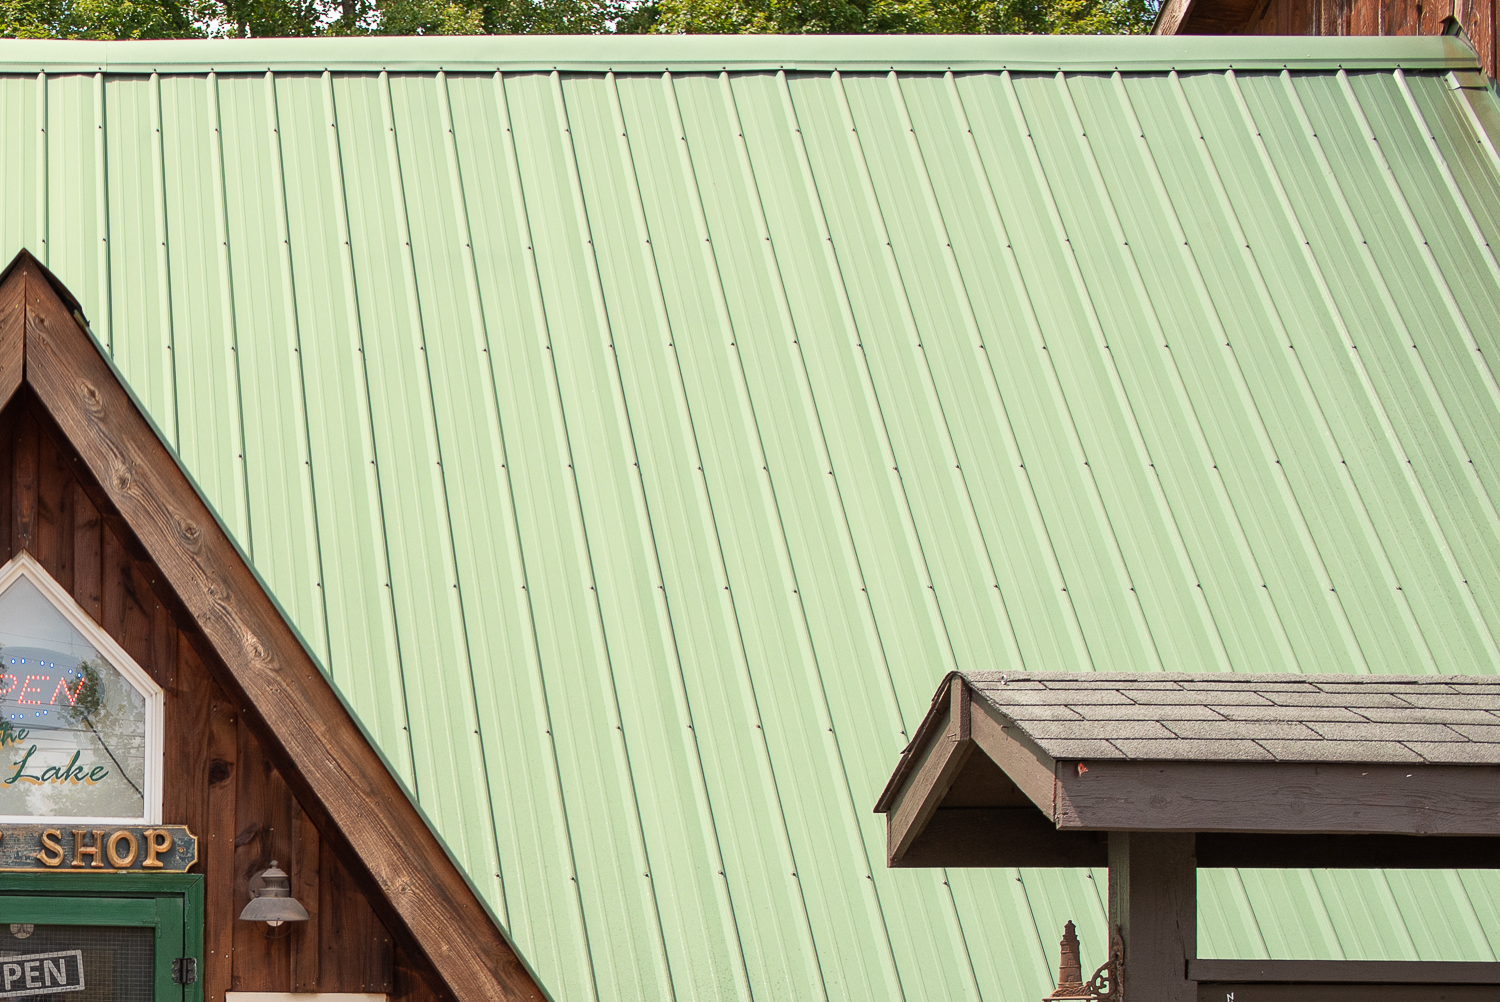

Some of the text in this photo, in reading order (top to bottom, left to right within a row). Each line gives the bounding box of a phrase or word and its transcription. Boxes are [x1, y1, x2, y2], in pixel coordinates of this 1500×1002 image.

[0, 744, 109, 788] Lake
[36, 829, 173, 868] SHOP
[1226, 992, 1235, 1002] N
